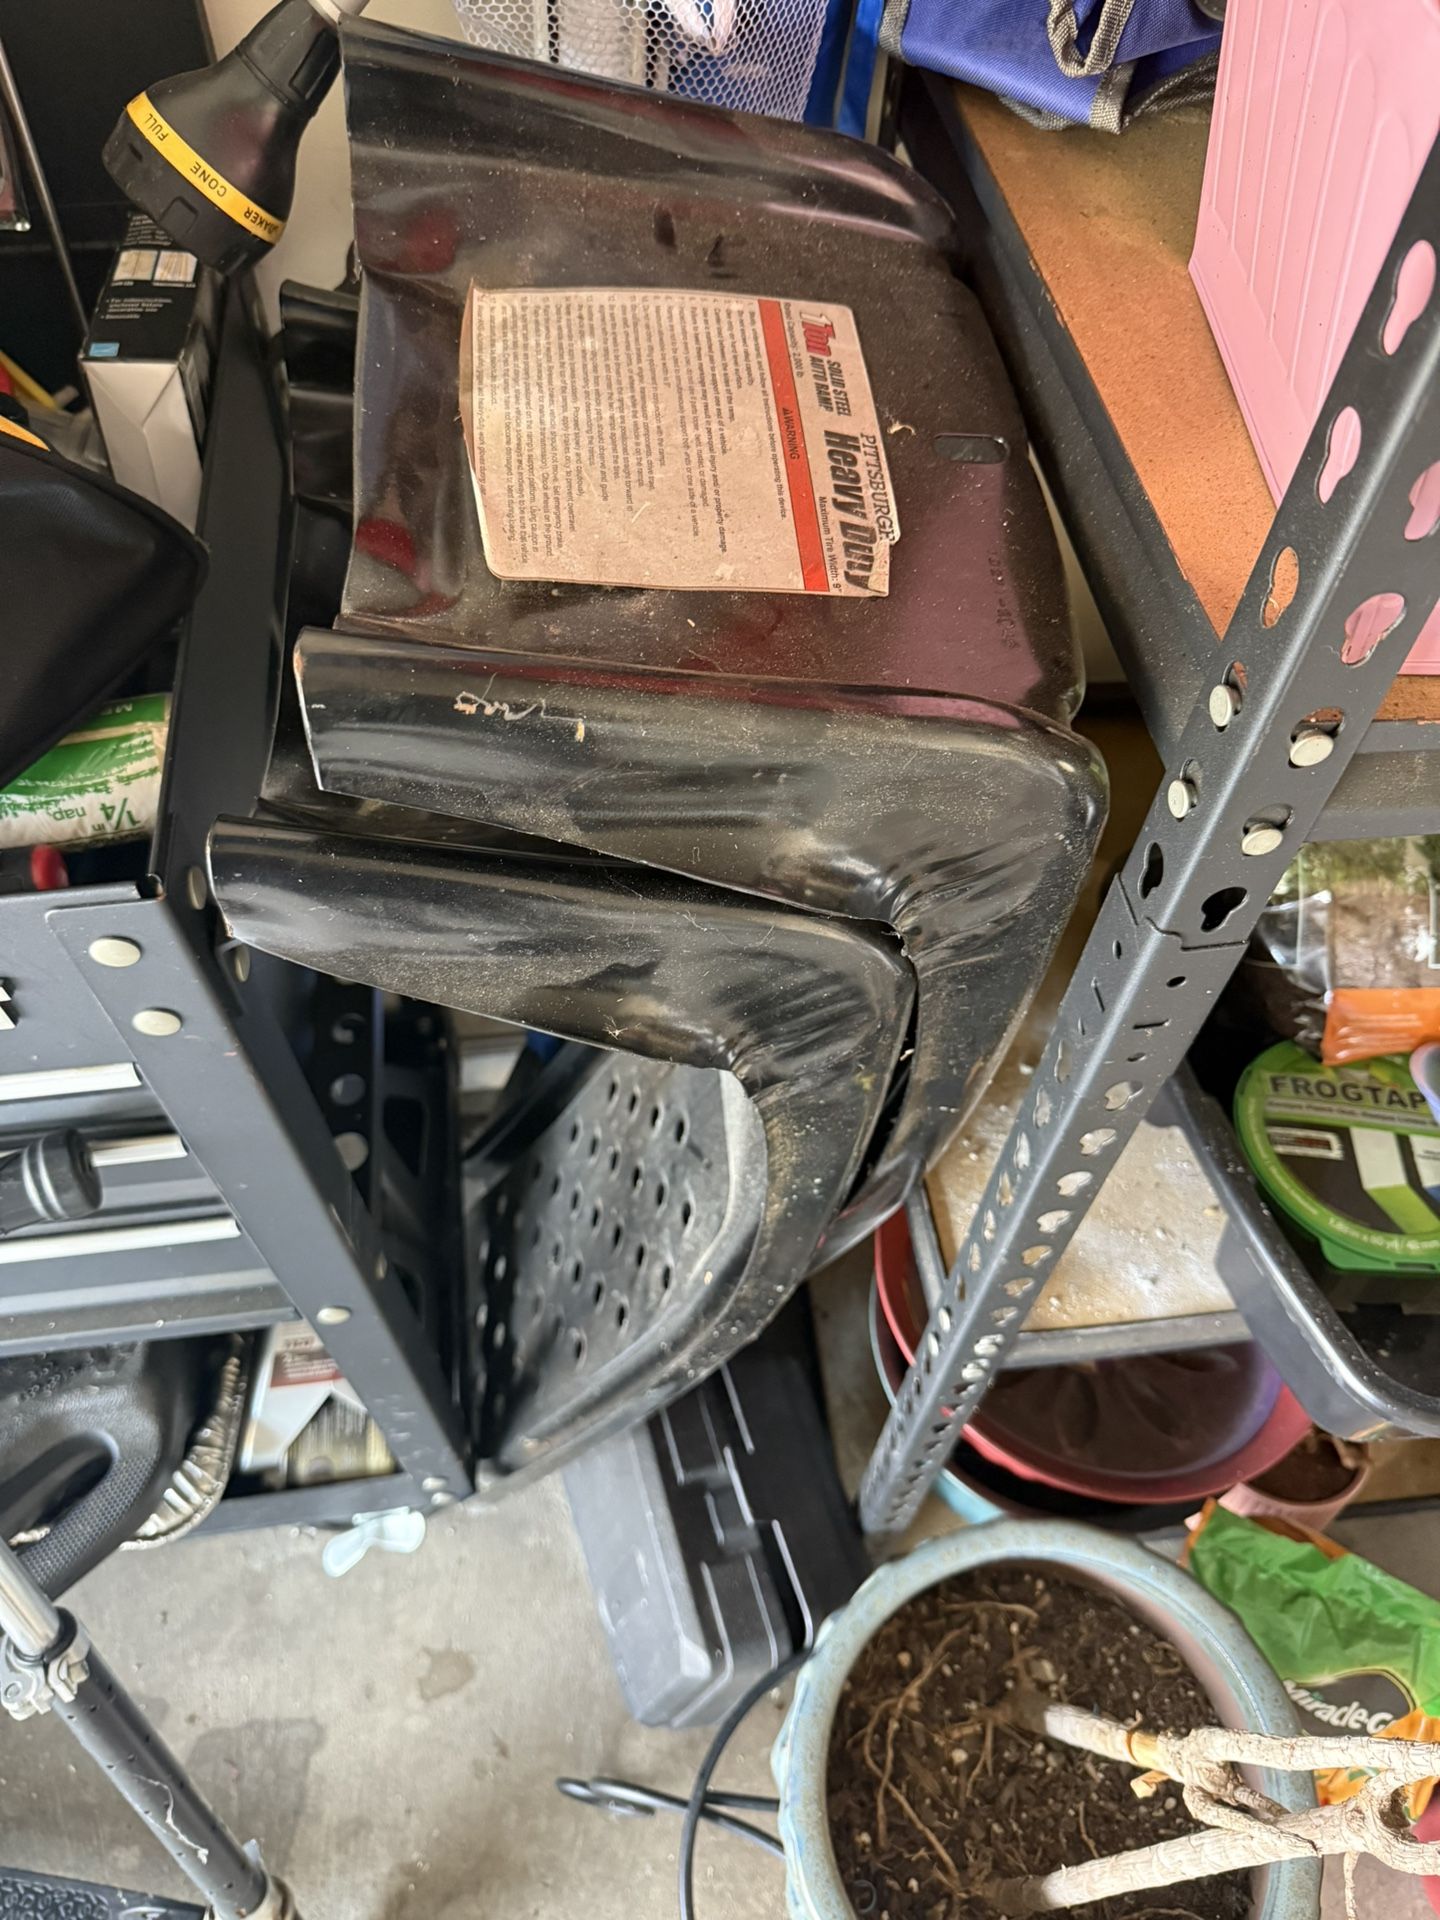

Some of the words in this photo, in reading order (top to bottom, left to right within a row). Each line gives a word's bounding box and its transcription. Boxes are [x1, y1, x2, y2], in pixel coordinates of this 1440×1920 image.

[144, 113, 170, 142] FULL
[190, 161, 228, 198] CONE
[809, 356, 828, 381] AUTO
[827, 360, 845, 389] SOLID
[815, 382, 834, 412] RAMP
[834, 389, 852, 417] STEEL
[784, 415, 800, 460] WARNING
[824, 430, 868, 520] Heavy
[819, 496, 831, 534] Maximum
[825, 537, 834, 552] Tire
[827, 555, 840, 581] Width:
[53, 806, 87, 822] nap
[92, 823, 107, 833] in
[1269, 1075, 1427, 1110] FROGTAP
